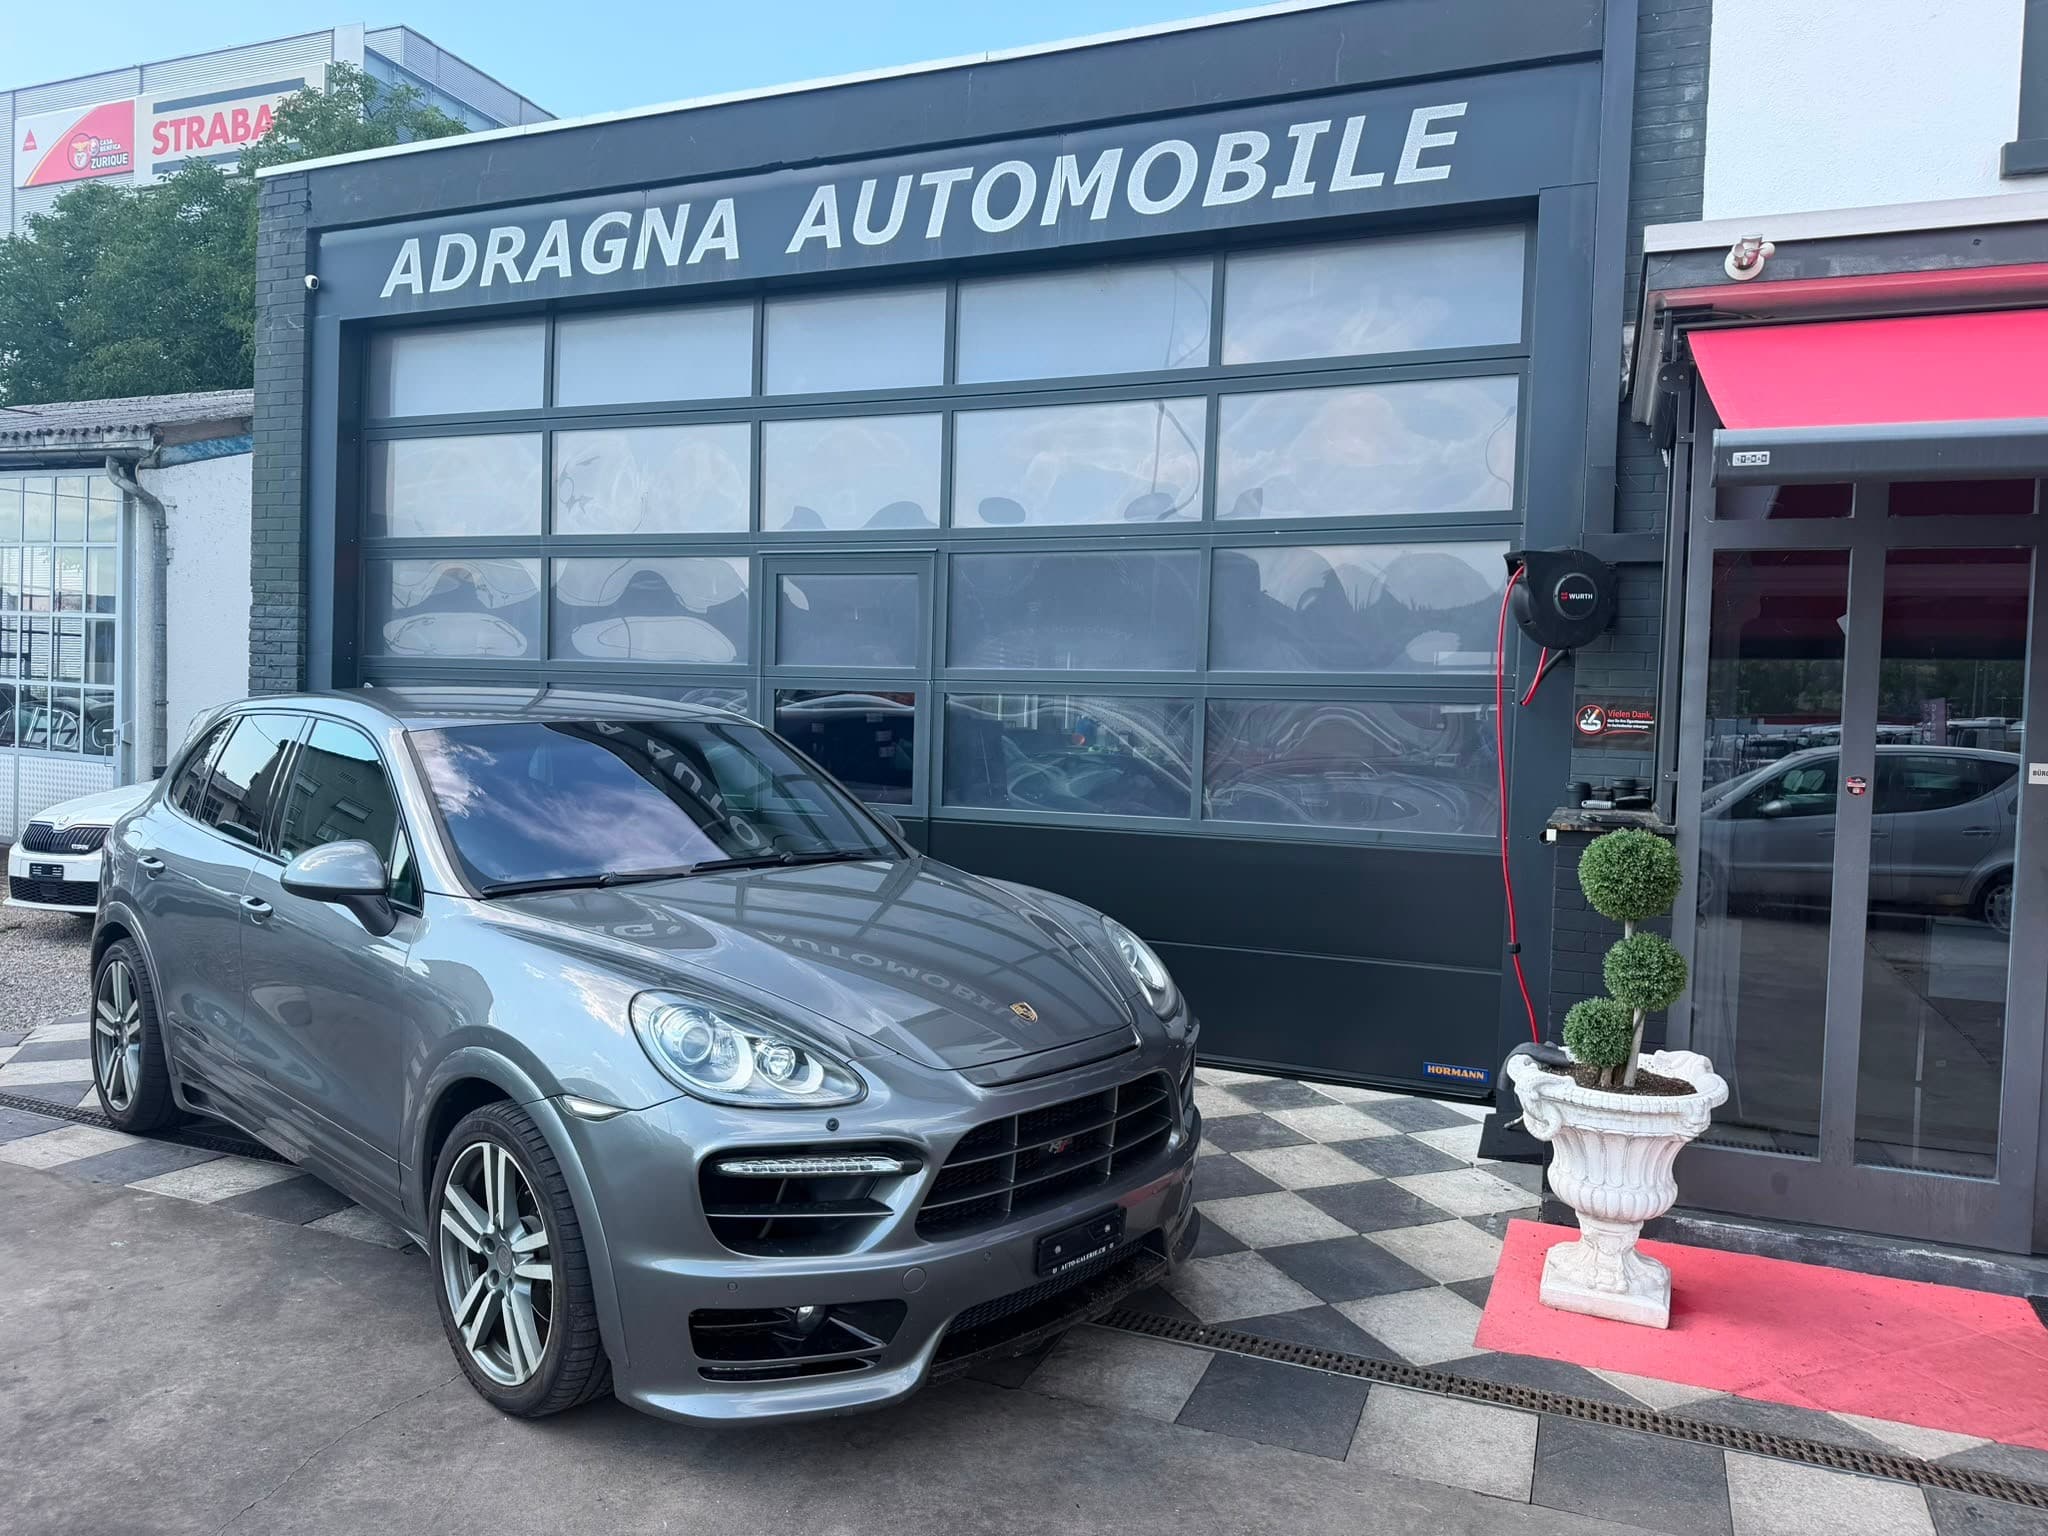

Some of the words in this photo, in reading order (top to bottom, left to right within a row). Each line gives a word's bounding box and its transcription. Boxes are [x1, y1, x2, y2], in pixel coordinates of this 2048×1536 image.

[152, 103, 277, 156] STRABA
[91, 153, 129, 169] ZURIQUE
[380, 197, 740, 298] ADRAGNA
[785, 102, 1468, 254] AUTOMOBILE
[1607, 709, 1631, 719] Vielen
